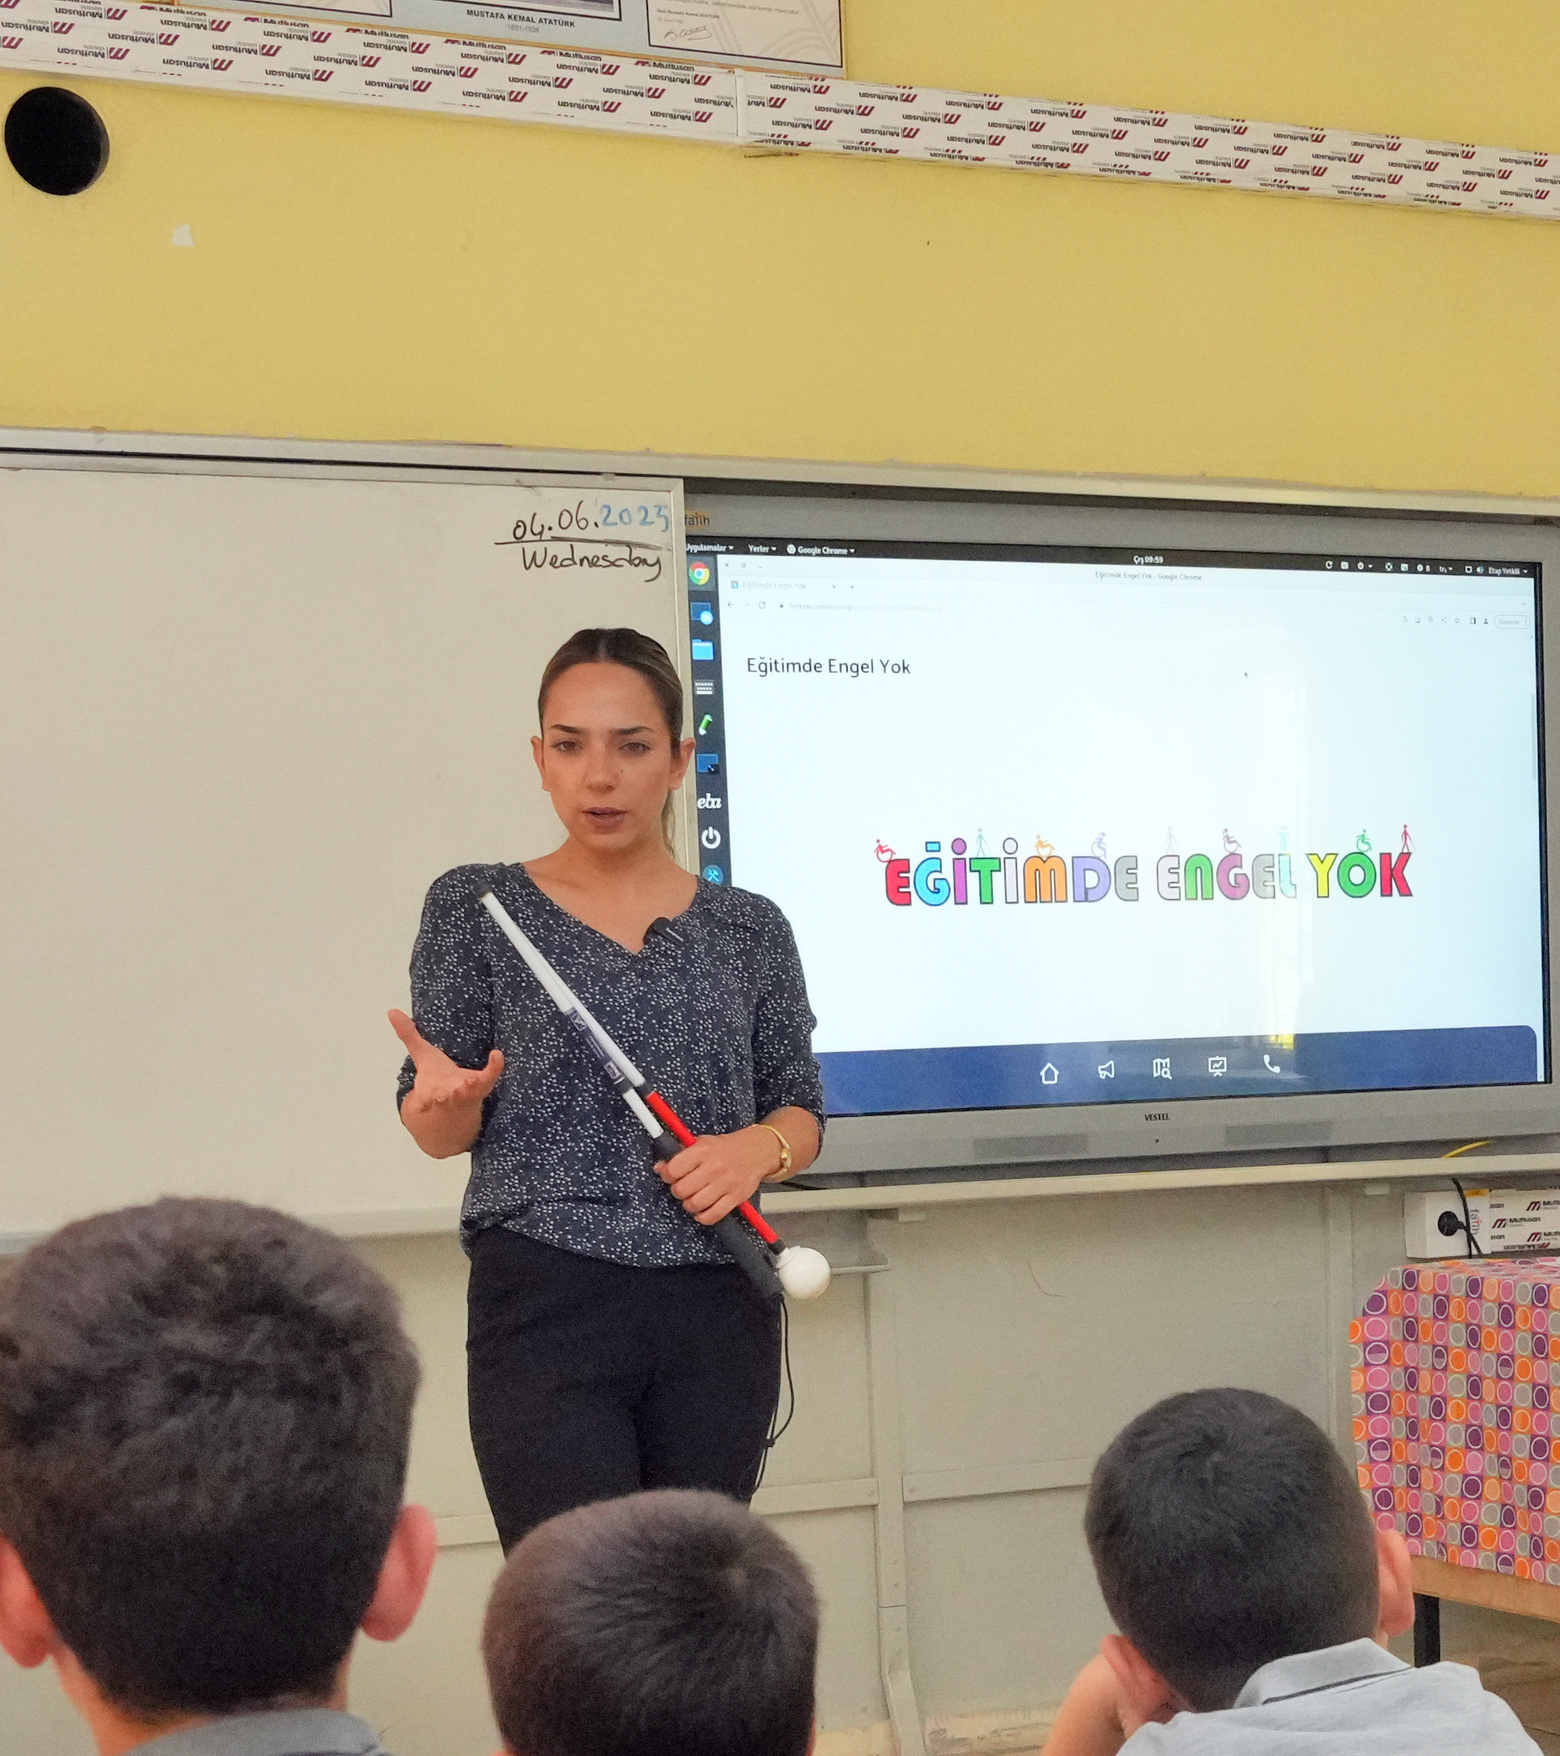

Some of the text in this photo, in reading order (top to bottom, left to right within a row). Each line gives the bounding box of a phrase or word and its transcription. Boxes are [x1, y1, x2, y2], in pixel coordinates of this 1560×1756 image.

[466, 8, 505, 20] MUSTAFA
[507, 14, 536, 24] KEMAL
[749, 545, 769, 554] Yerler
[798, 546, 848, 555] Google Chrome
[522, 544, 662, 583] Wednesday
[1157, 573, 1178, 581] Google
[747, 656, 911, 678] Eğitimde Engel Yok
[697, 793, 722, 809] eba
[885, 837, 1413, 906] EĞİTİMDE ENGEL YOK
[1145, 1113, 1170, 1121] VESTEL
